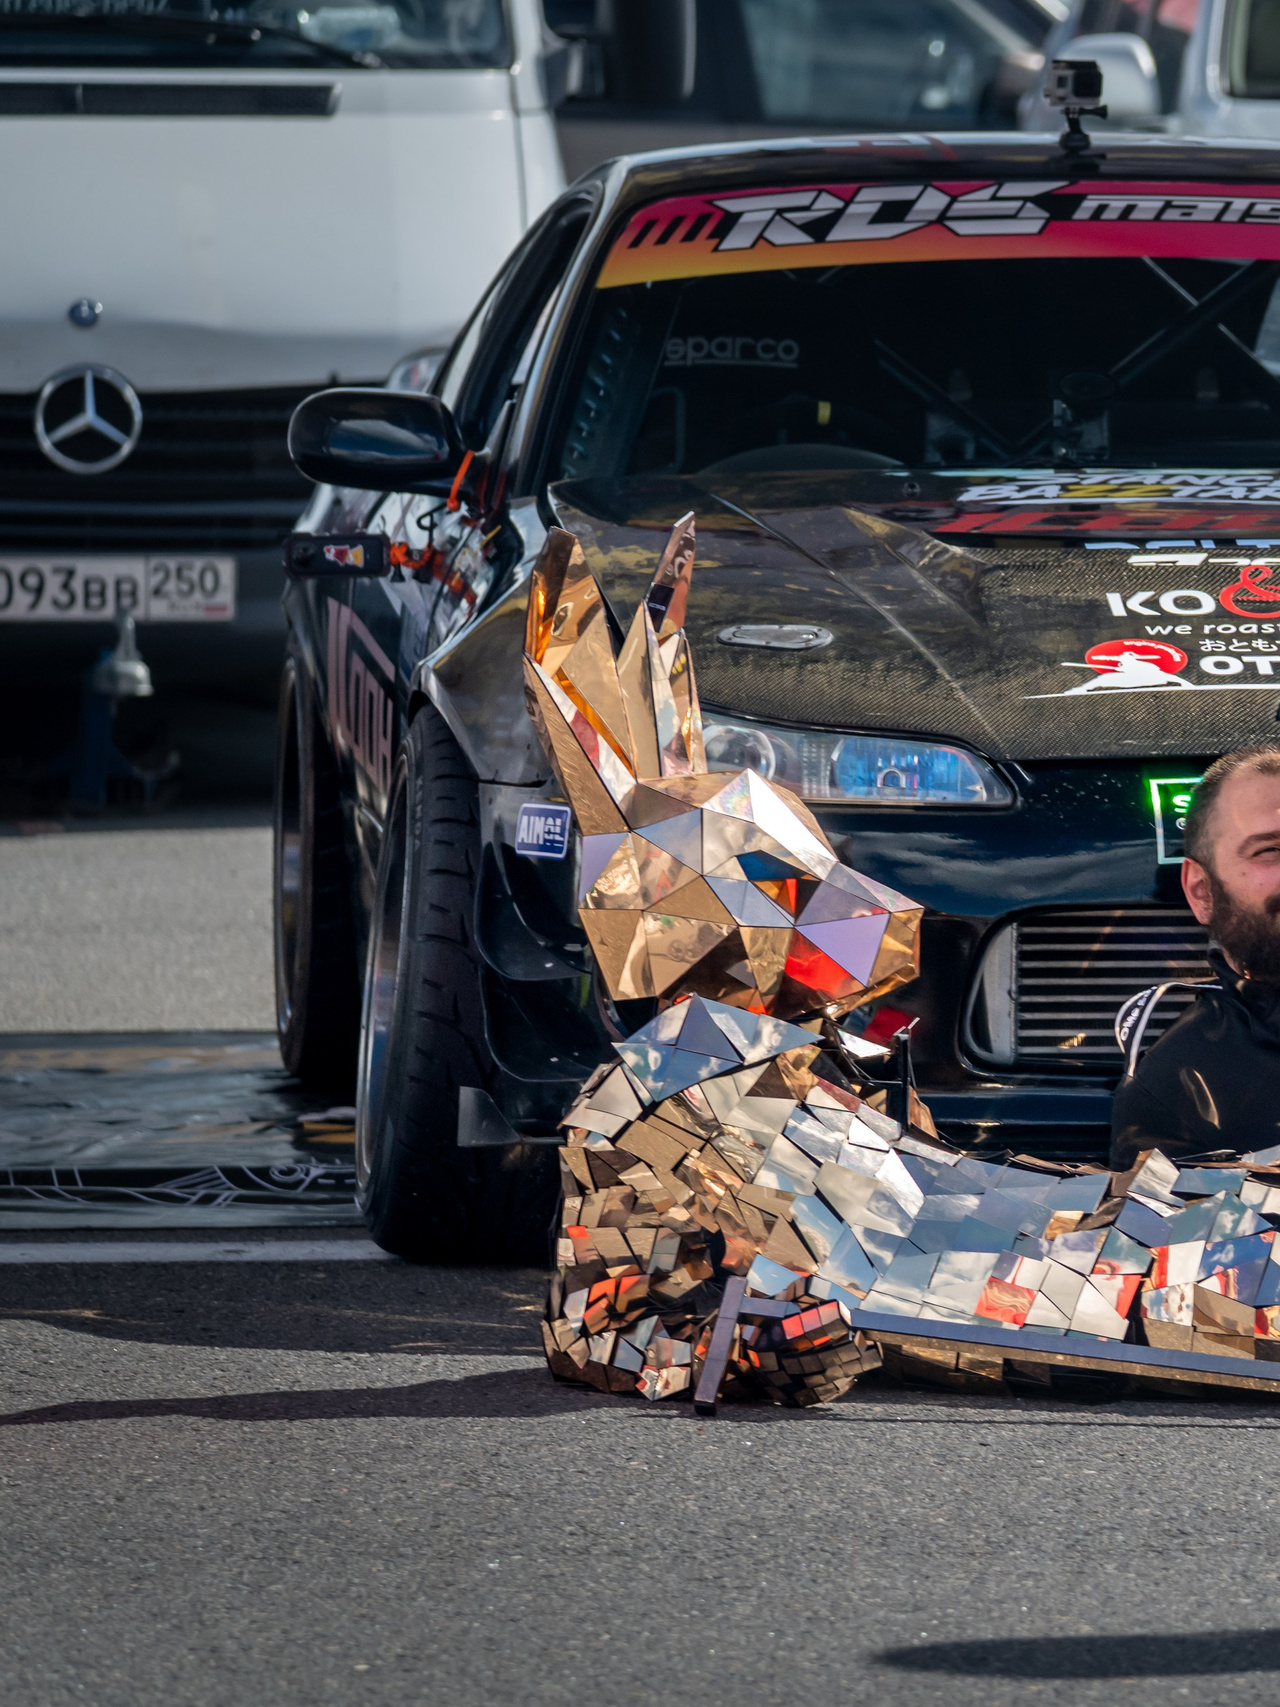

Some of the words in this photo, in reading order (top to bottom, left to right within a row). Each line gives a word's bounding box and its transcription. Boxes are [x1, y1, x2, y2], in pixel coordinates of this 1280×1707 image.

[711, 180, 1070, 251] RDS
[666, 335, 800, 367] sparco
[152, 562, 220, 599] 250
[1145, 624, 1193, 636] we
